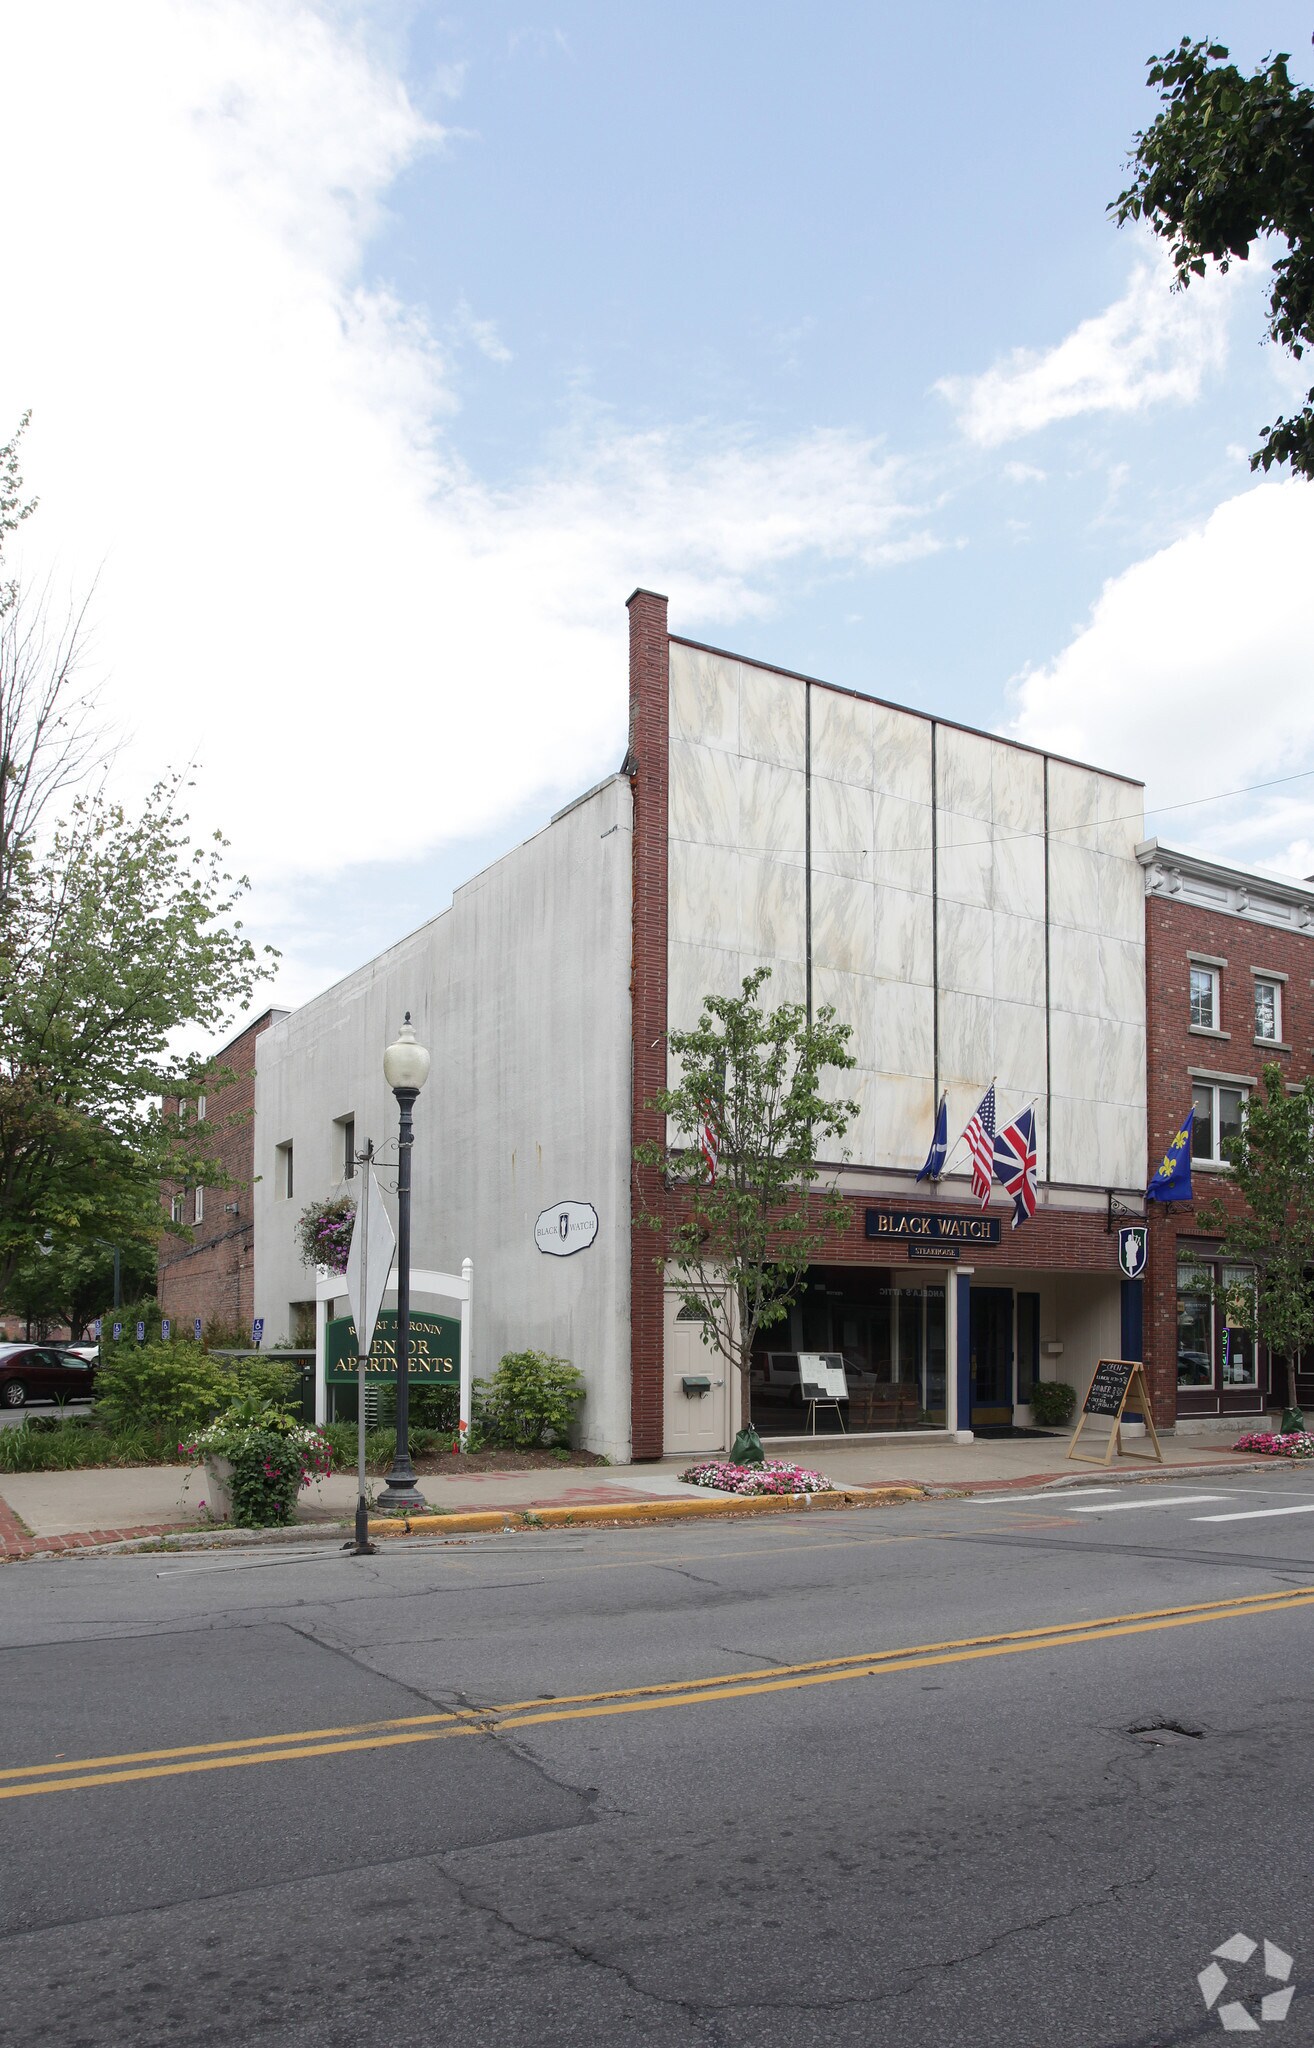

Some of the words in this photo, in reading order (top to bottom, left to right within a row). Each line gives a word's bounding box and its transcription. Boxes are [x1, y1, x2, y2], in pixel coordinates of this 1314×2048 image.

[537, 1226, 558, 1236] BLACK
[570, 1221, 594, 1231] WATCH
[878, 1215, 931, 1234] BLACK
[938, 1219, 990, 1238] WATCH
[915, 1247, 956, 1256] STEAKHOUSE
[408, 1321, 443, 1335] RONIN
